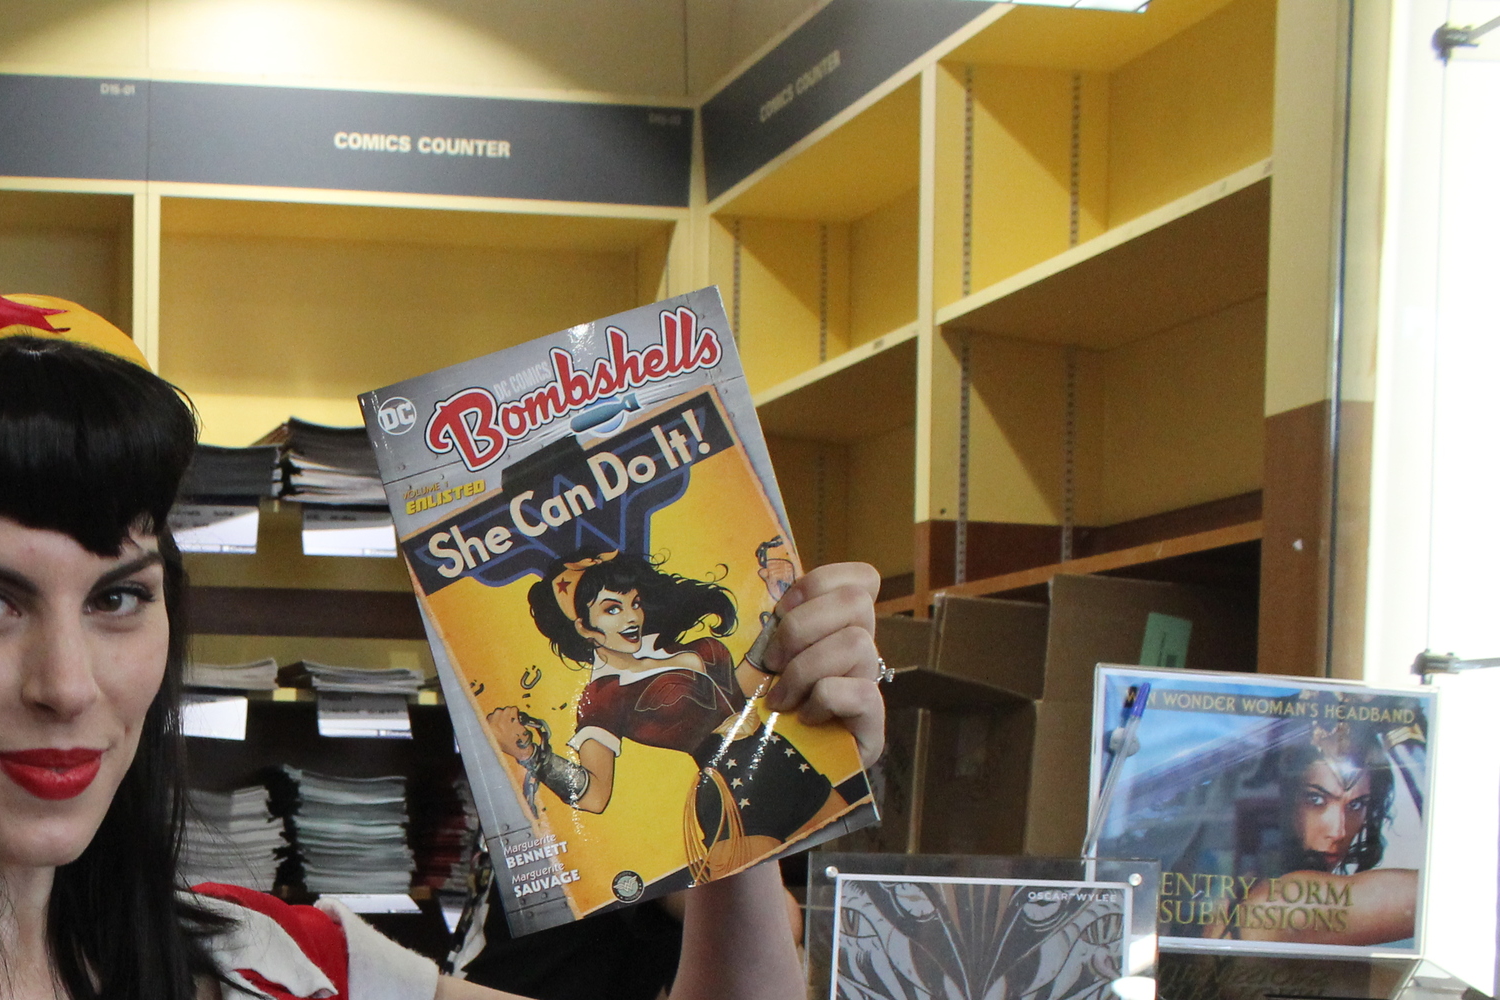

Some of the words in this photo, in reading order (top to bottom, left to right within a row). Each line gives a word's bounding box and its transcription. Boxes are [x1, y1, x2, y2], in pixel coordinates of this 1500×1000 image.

[334, 132, 410, 153] COMICS
[418, 136, 510, 158] COUNTER
[424, 307, 722, 472] Bombshells
[380, 401, 415, 430] DC
[405, 478, 486, 515] ENLISTED
[427, 525, 512, 580] She
[509, 481, 596, 538] Can
[586, 451, 656, 502] Do
[656, 409, 711, 470] It!
[1126, 690, 1156, 706] WN
[1162, 694, 1235, 711] WONDER
[1243, 700, 1318, 718] WOMAN'S
[1324, 705, 1415, 724] HEADBAND
[503, 832, 557, 856] Marguerite
[505, 840, 569, 869] BENNETT
[511, 861, 565, 885] Marguerite
[513, 868, 580, 898] SAUVAGE
[1028, 891, 1068, 901] OSCAR
[1075, 893, 1117, 902] WYLEE
[1161, 872, 1255, 899] ENTRY
[1269, 878, 1353, 906] FORM
[1159, 899, 1348, 932] SUBMISSIONS
